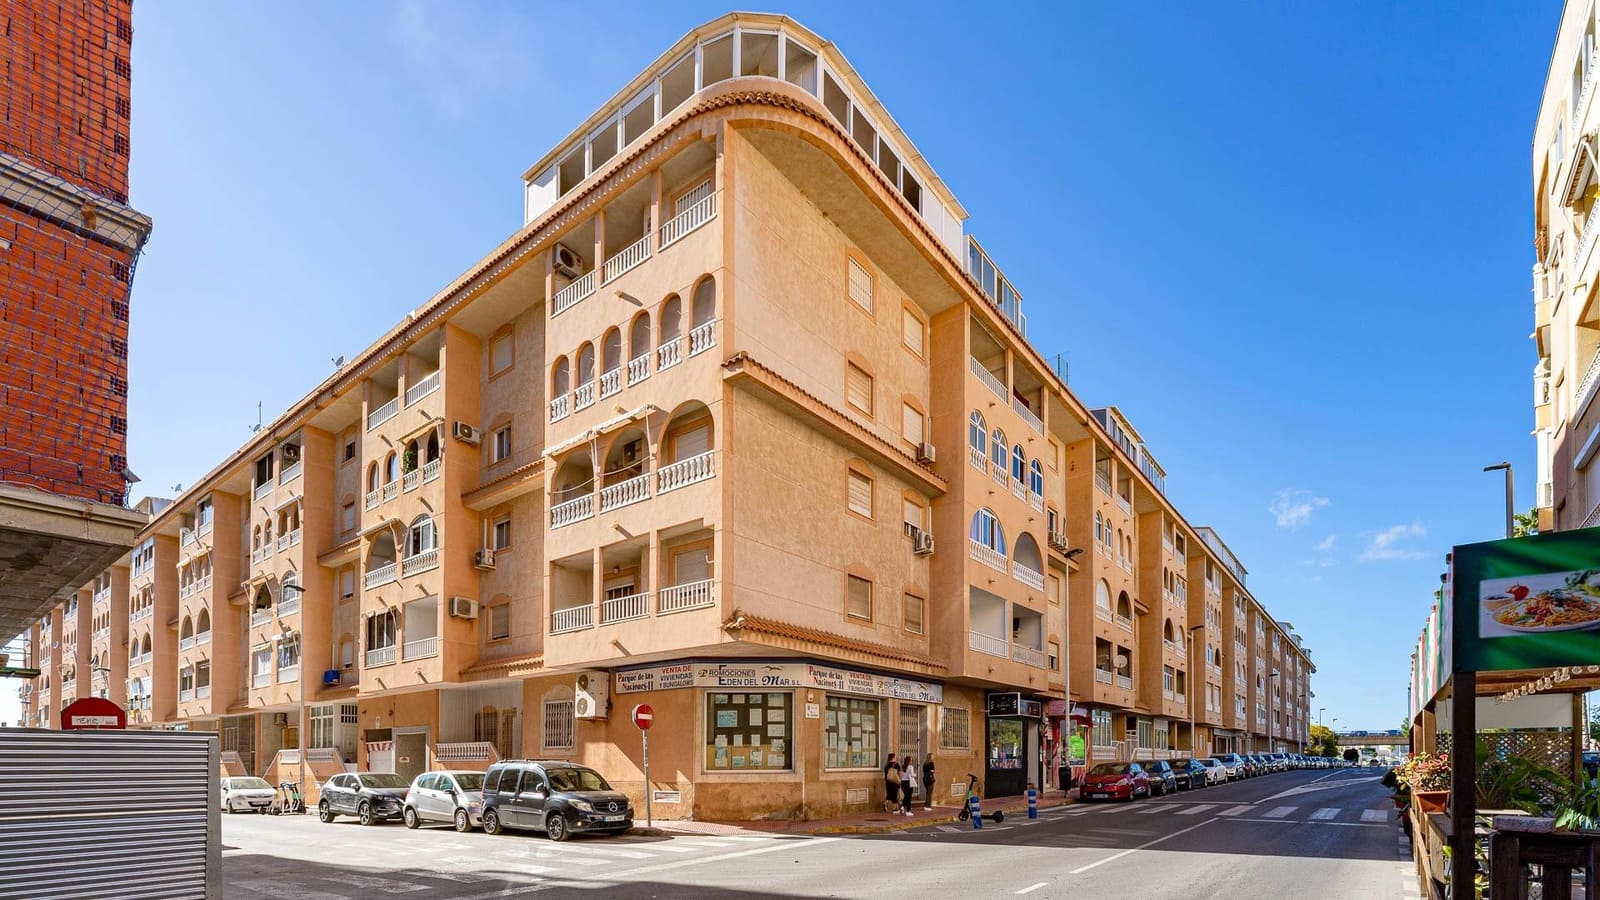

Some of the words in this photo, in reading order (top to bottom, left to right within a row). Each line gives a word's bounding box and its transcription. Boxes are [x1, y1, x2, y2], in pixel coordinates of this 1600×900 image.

[662, 666, 681, 674] VENTA
[698, 669, 756, 678] PROMOCIONES
[618, 673, 637, 684] Parque
[637, 673, 644, 681] de
[645, 672, 654, 680] las
[660, 673, 693, 681] VIVIENDAS
[762, 676, 790, 686] MAR
